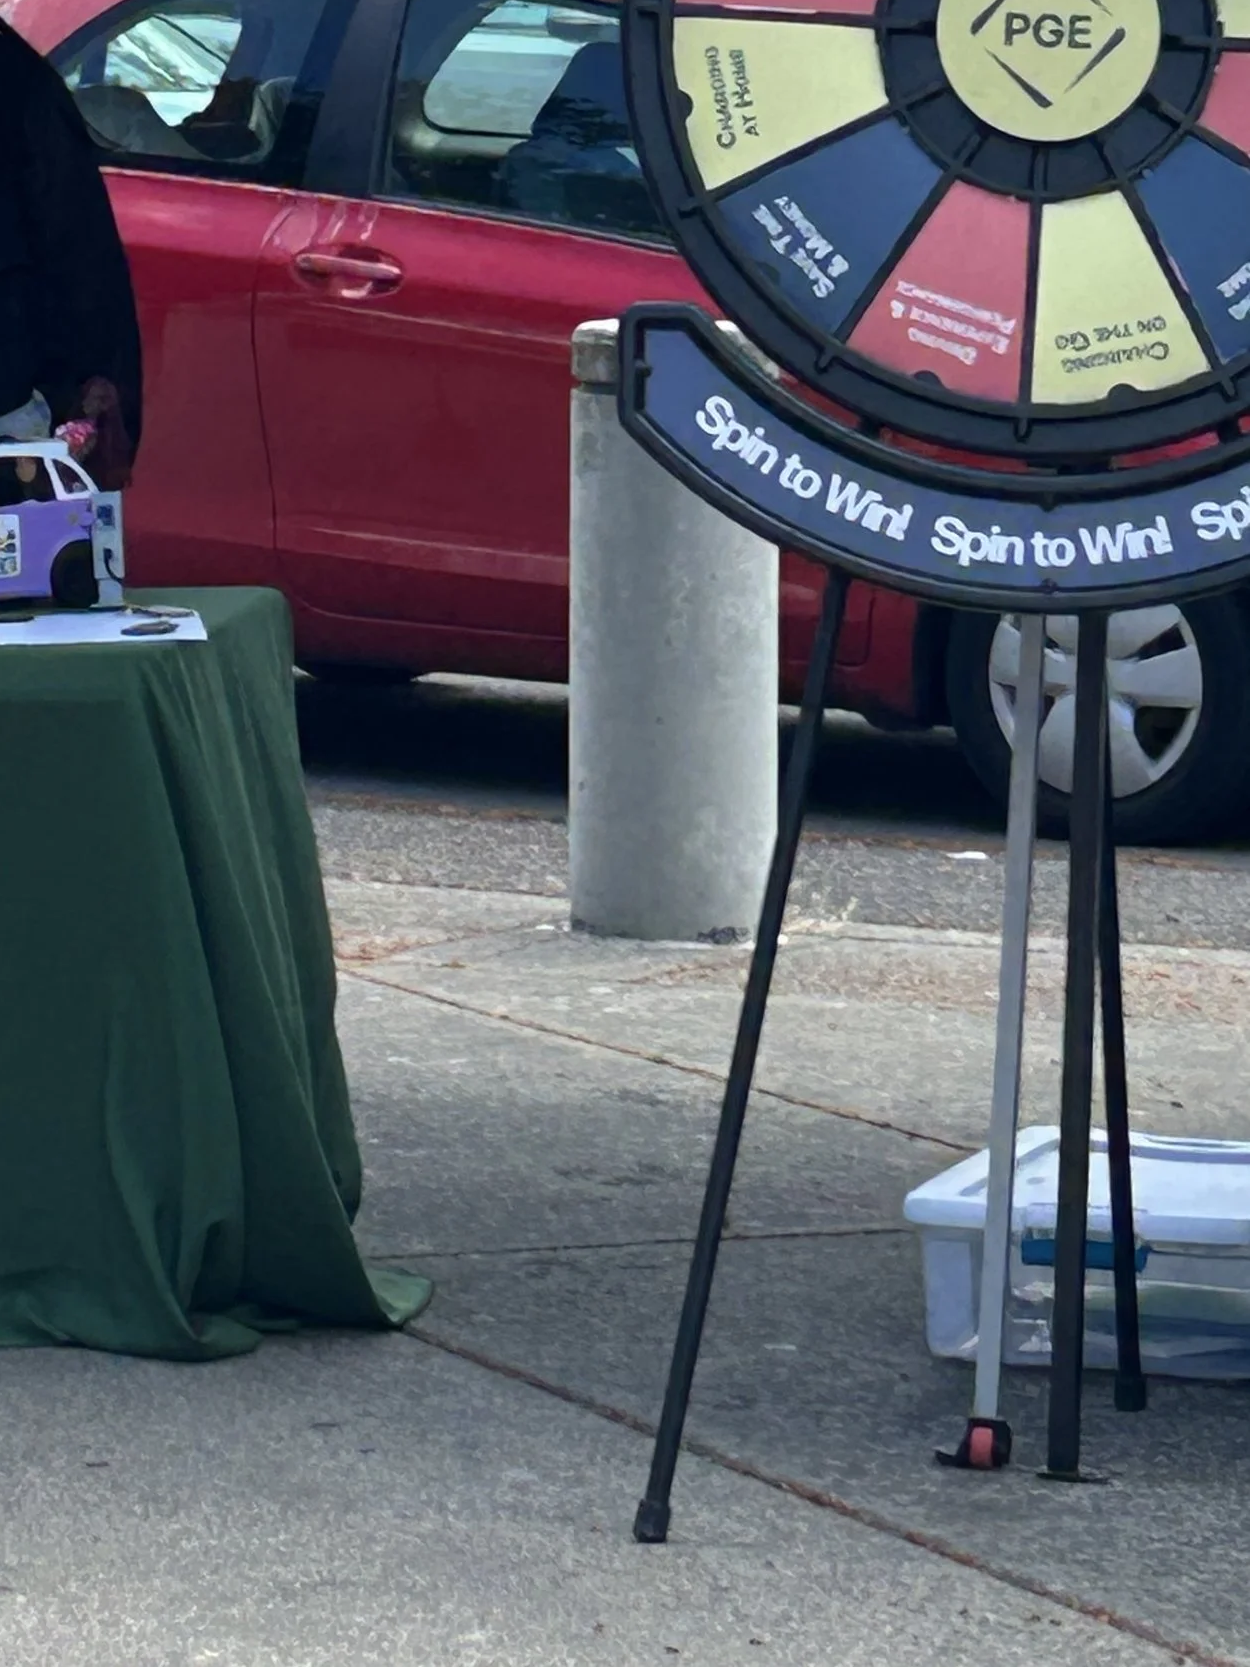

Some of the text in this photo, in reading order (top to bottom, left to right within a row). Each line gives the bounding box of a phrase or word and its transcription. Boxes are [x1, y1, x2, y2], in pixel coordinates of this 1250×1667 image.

[1004, 12, 1093, 50] PGE
[695, 395, 779, 475] Spin
[779, 453, 822, 499] to
[930, 515, 1025, 567] Spin
[1030, 531, 1076, 567] to
